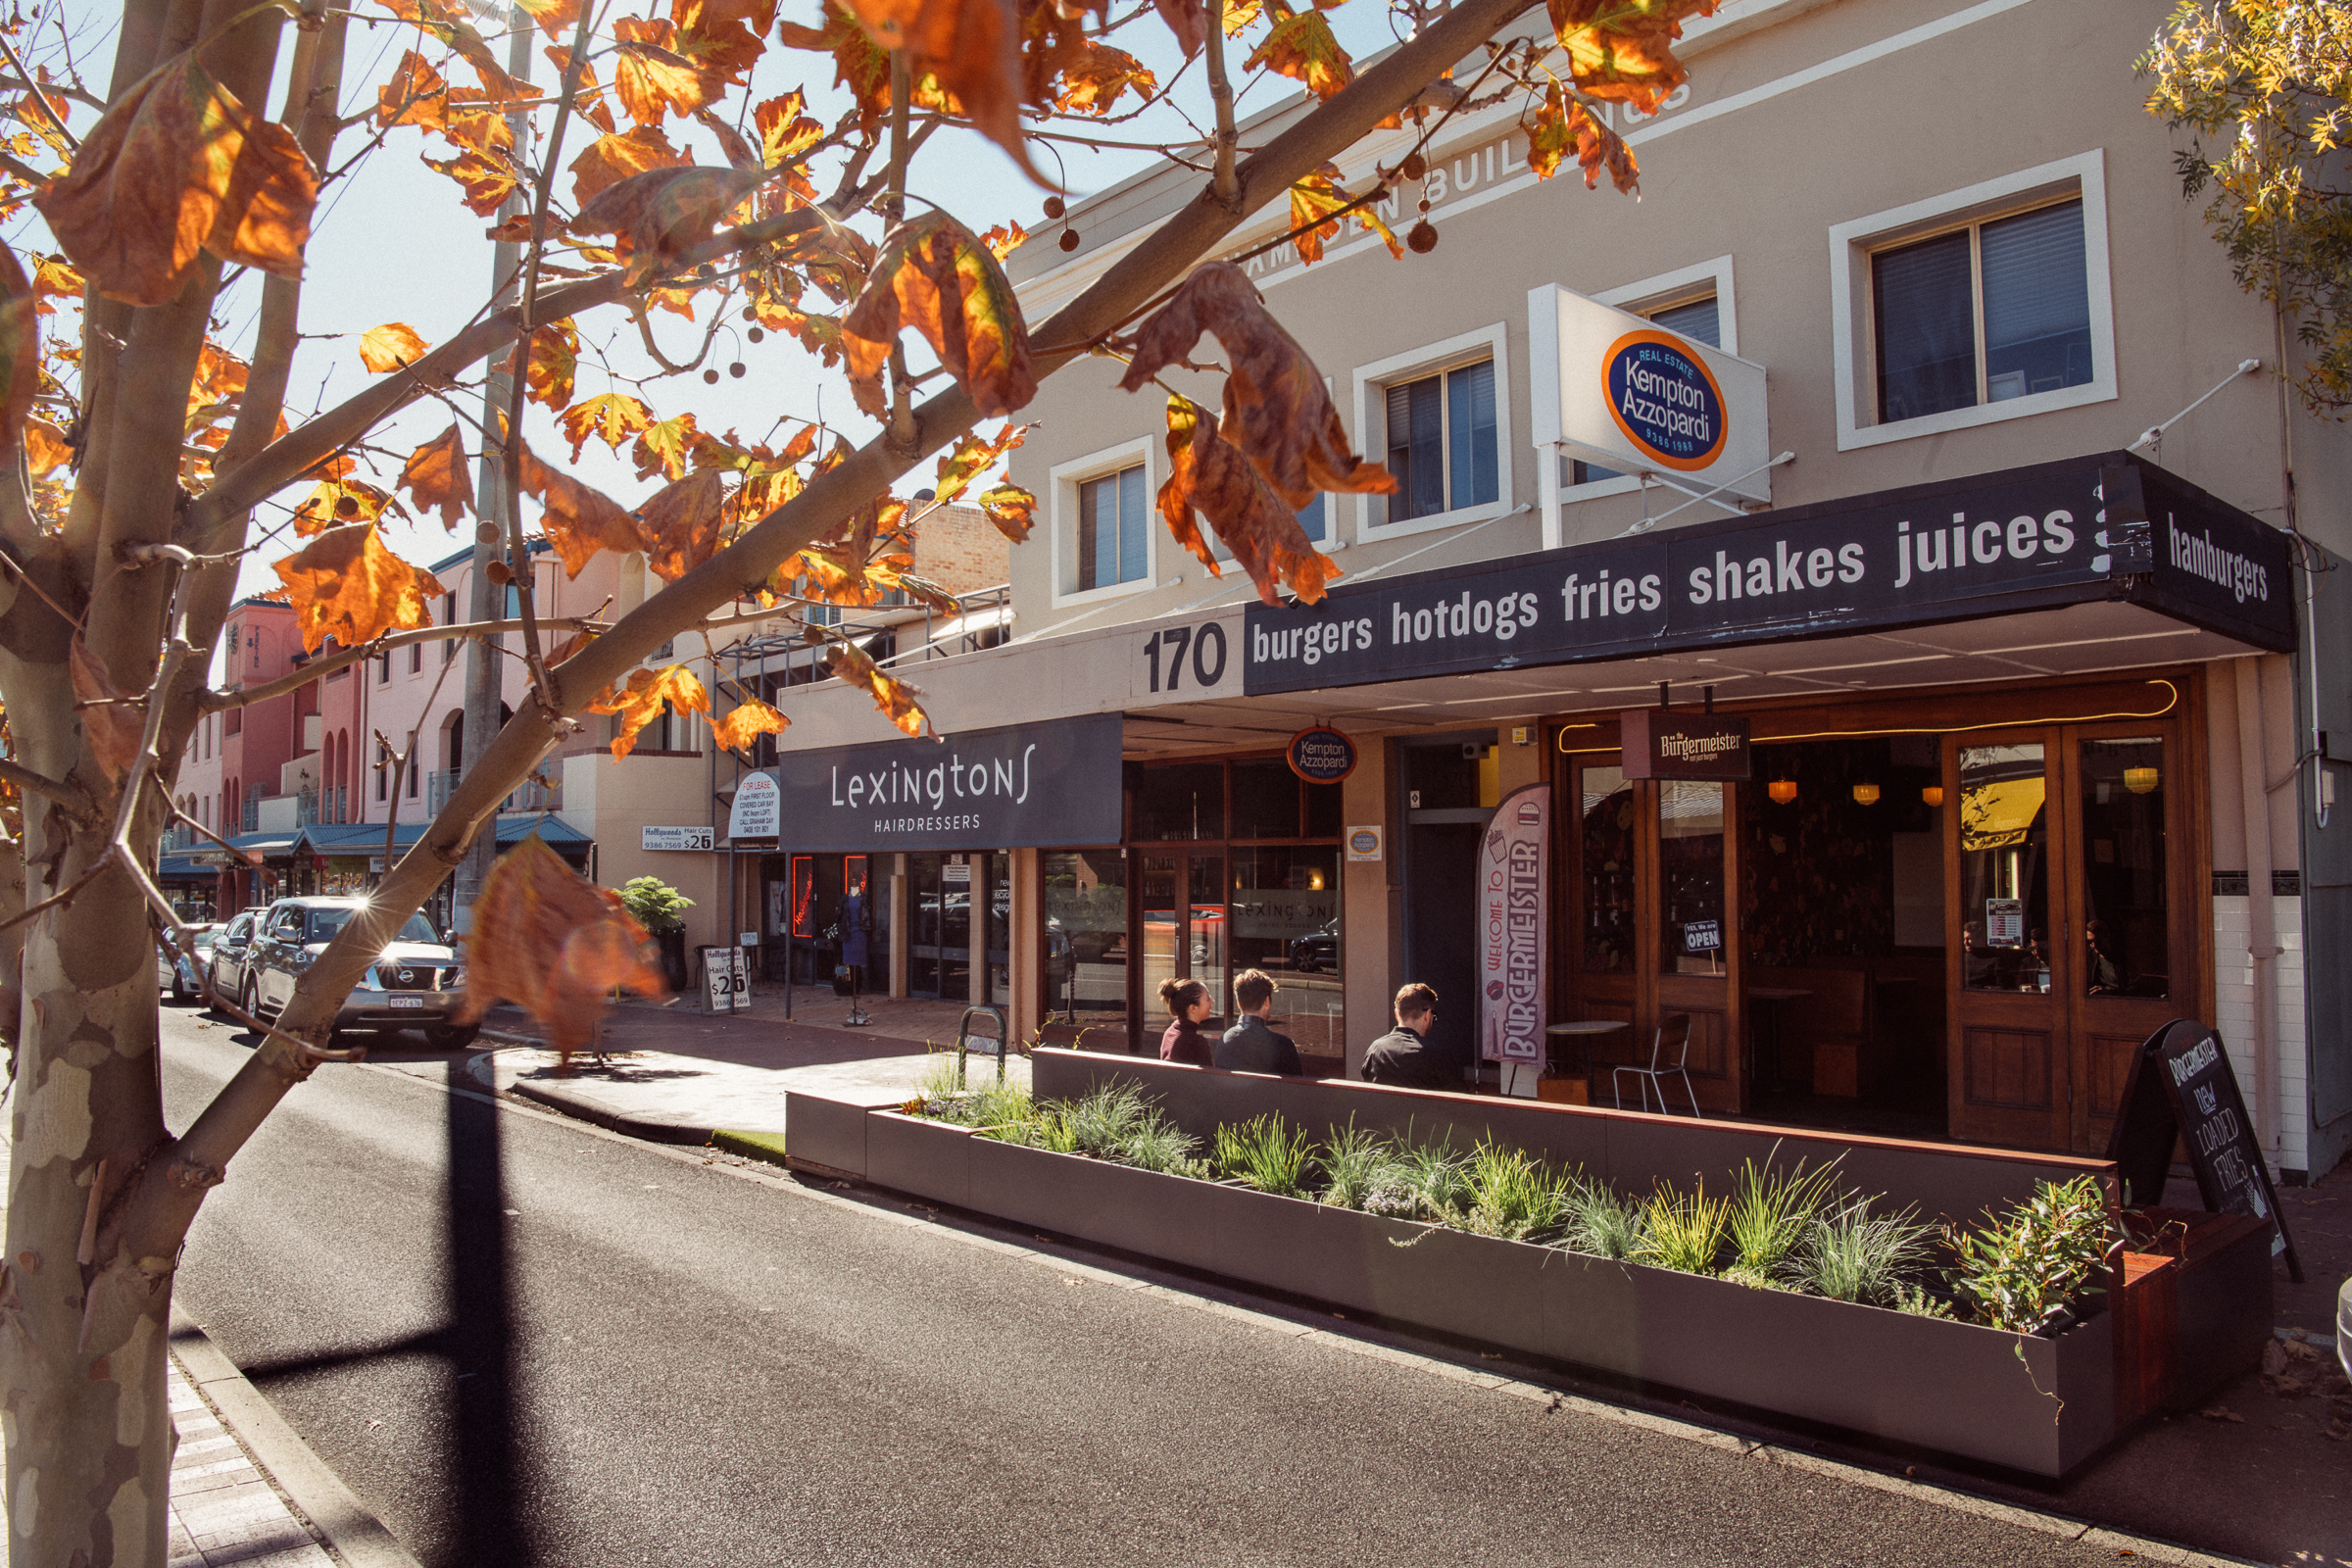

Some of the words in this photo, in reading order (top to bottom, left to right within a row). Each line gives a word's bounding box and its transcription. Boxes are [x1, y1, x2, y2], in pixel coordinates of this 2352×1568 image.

[1640, 350, 1661, 362] REAL
[1665, 354, 1693, 379] ESTATE
[1626, 357, 1704, 412] Kempton
[1623, 387, 1709, 441] Azzopardi
[1646, 428, 1669, 448] 9386
[1673, 440, 1692, 452] 1988
[2168, 512, 2268, 604] hamburgers
[1253, 617, 1372, 665] burgers
[1392, 591, 1539, 644] hotdogs
[1561, 570, 1662, 621] fries
[1690, 541, 1865, 606] shakes
[1895, 510, 2075, 588] juices
[1144, 621, 1227, 693] 170
[1301, 741, 1345, 757] Kempton
[1661, 732, 1740, 760] Bürgermeister
[1299, 754, 1348, 770] Azzopardi
[743, 782, 754, 791] FOR
[755, 780, 771, 790] LEASE
[645, 827, 682, 837] Hollywoods
[874, 814, 980, 833] HAIRDRESSERS
[1488, 870, 1503, 893] TO
[1488, 900, 1503, 971] WELCOME
[1504, 840, 1540, 1059] BÜRGERMEISTER
[1688, 931, 1719, 948] OPEN
[709, 965, 724, 974] Hair
[2193, 1081, 2217, 1111] new
[2196, 1107, 2238, 1156] LOADED
[2214, 1146, 2249, 1192] FRIES
